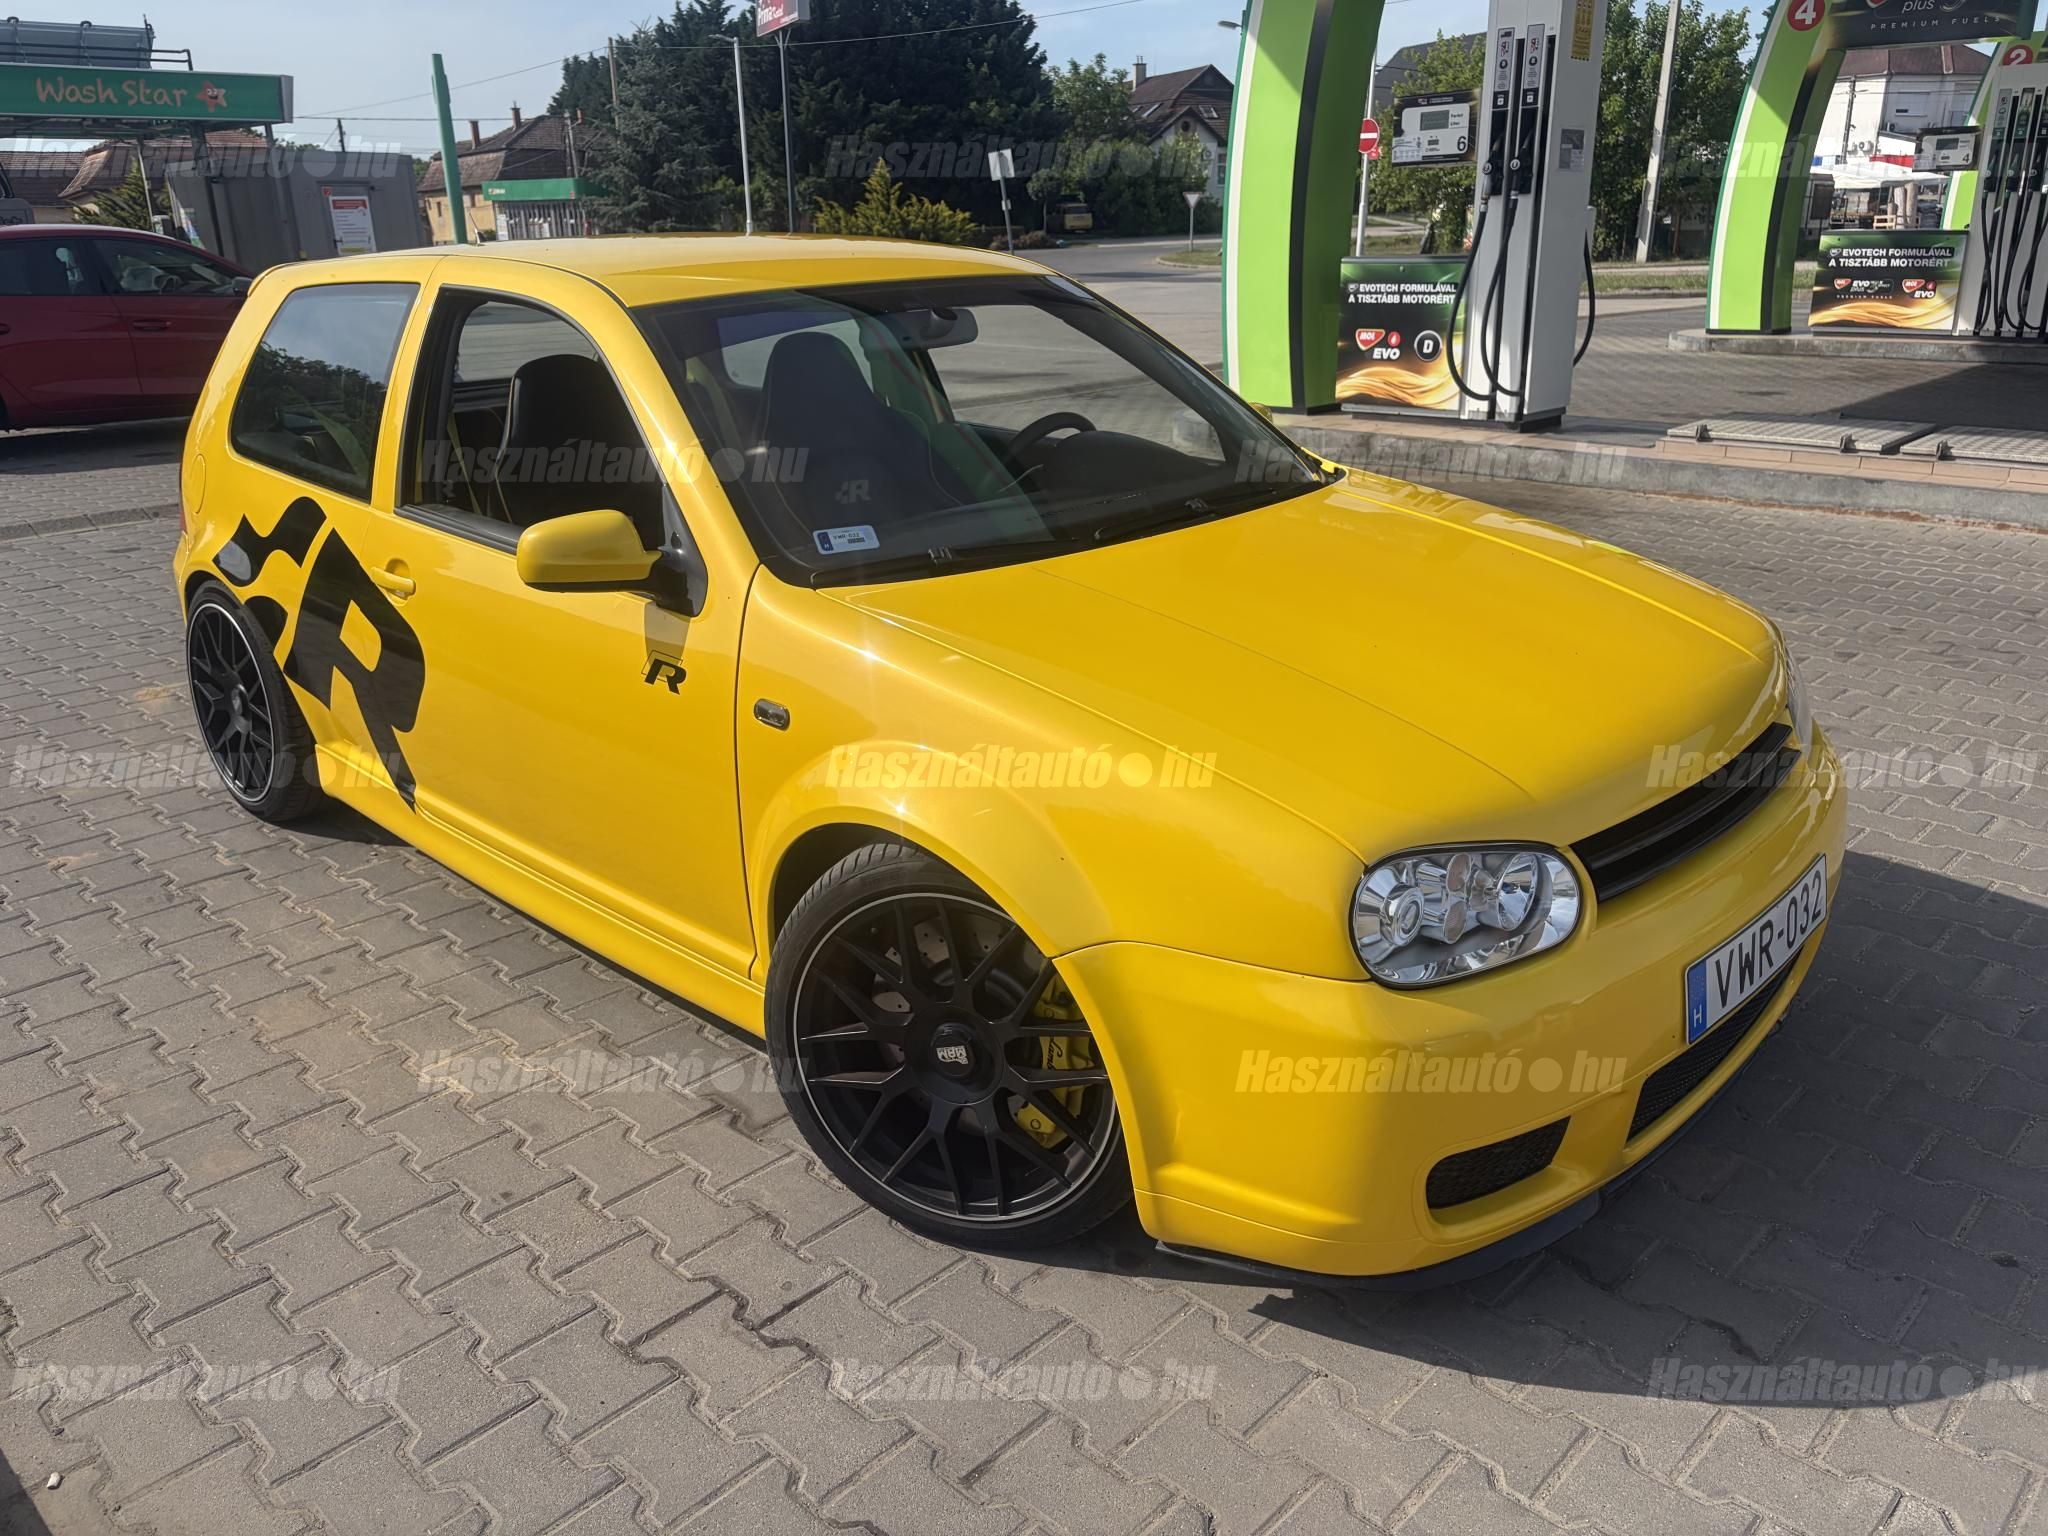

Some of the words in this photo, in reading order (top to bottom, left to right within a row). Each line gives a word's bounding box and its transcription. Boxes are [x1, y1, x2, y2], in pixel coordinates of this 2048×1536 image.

[1795, 0, 1817, 25] 4
[1870, 19, 1939, 30] PREMIUM
[1951, 15, 2001, 26] FUELS
[2009, 48, 2027, 66] 2
[36, 76, 118, 105] Wash
[122, 79, 188, 107] Star
[1457, 135, 1467, 152] 6
[1962, 153, 1970, 163] 4
[1842, 248, 1887, 257] EVOTECH
[1888, 247, 1952, 257] FORMULÁVAL
[1828, 259, 1837, 267] A
[1840, 257, 1888, 267] TISZTÁBB
[1890, 257, 1949, 267] MOTORÉRT
[1359, 283, 1399, 293] EVOTECH
[1400, 281, 1456, 293] FORMULÁVAL
[1914, 290, 1935, 298] EVO
[1348, 294, 1355, 303] A
[1357, 292, 1400, 303] TISZTÁBB
[1402, 293, 1456, 304] MOTORÉRT
[1372, 347, 1401, 360] EVO
[1422, 339, 1434, 354] D
[644, 658, 687, 695] R
[1715, 869, 1822, 1009] VWR-032
[1693, 1004, 1702, 1028] H
